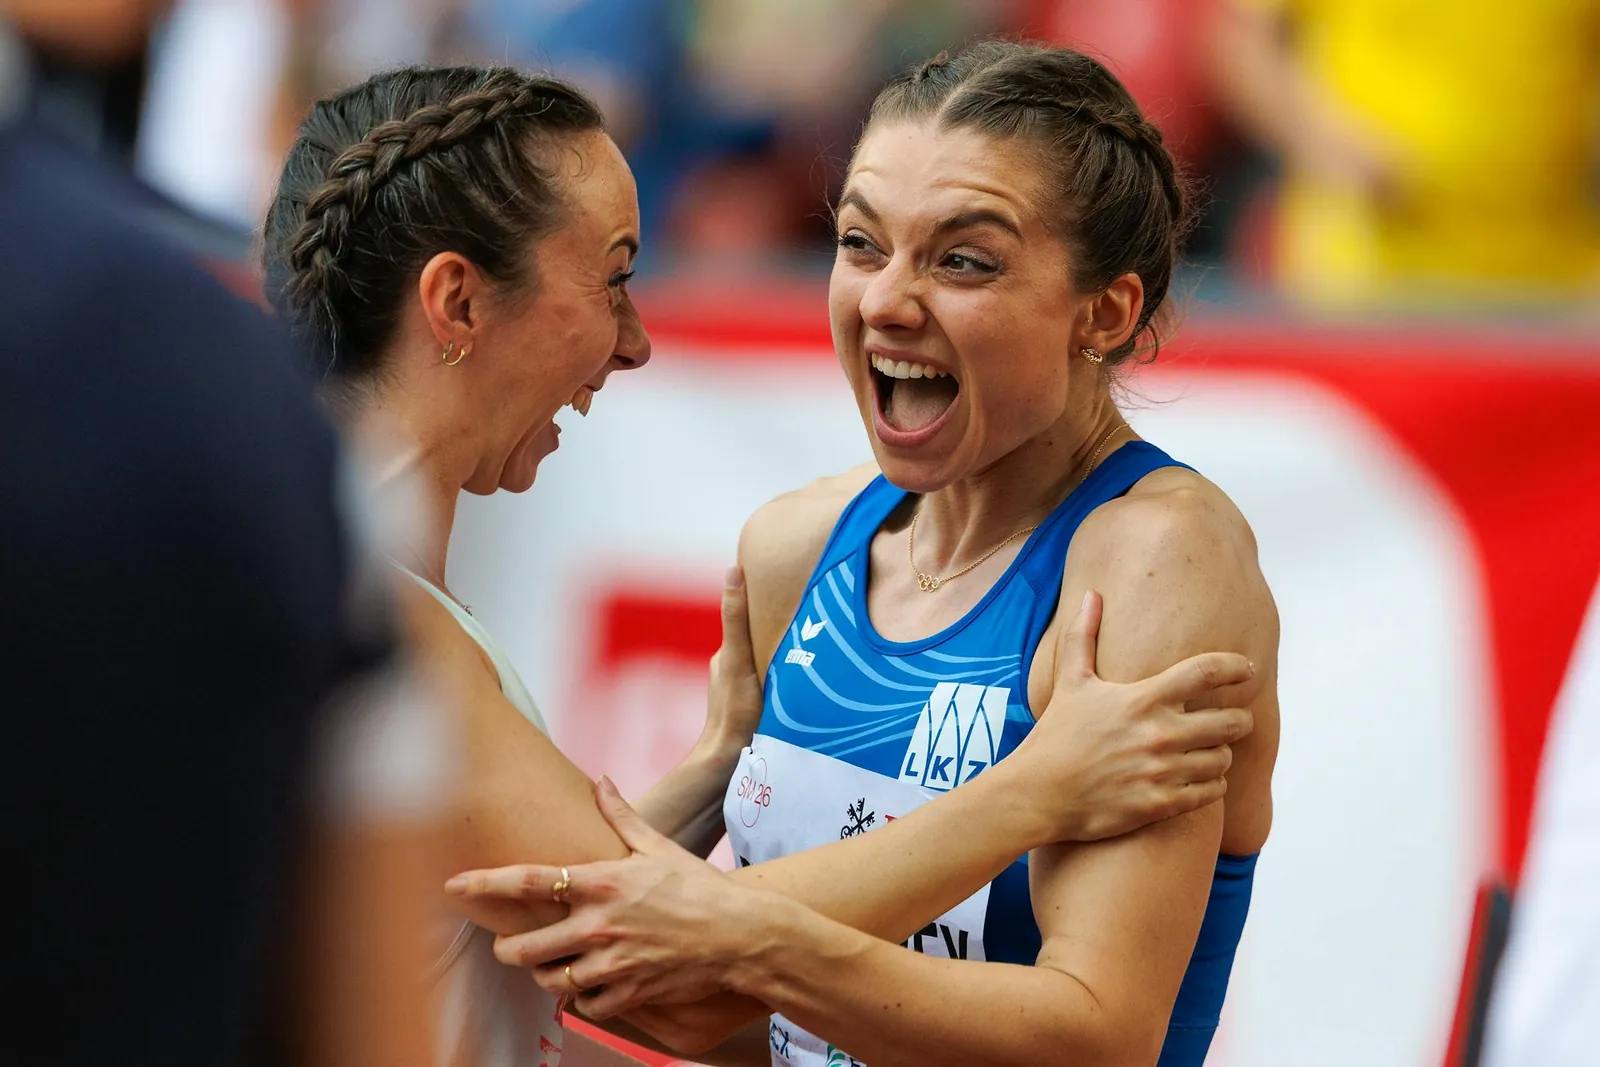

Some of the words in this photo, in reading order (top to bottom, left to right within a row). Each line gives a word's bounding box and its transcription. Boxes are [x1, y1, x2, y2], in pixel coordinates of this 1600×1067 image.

[905, 752, 988, 785] LKZ
[737, 775, 757, 801] SM
[754, 783, 772, 808] 26
